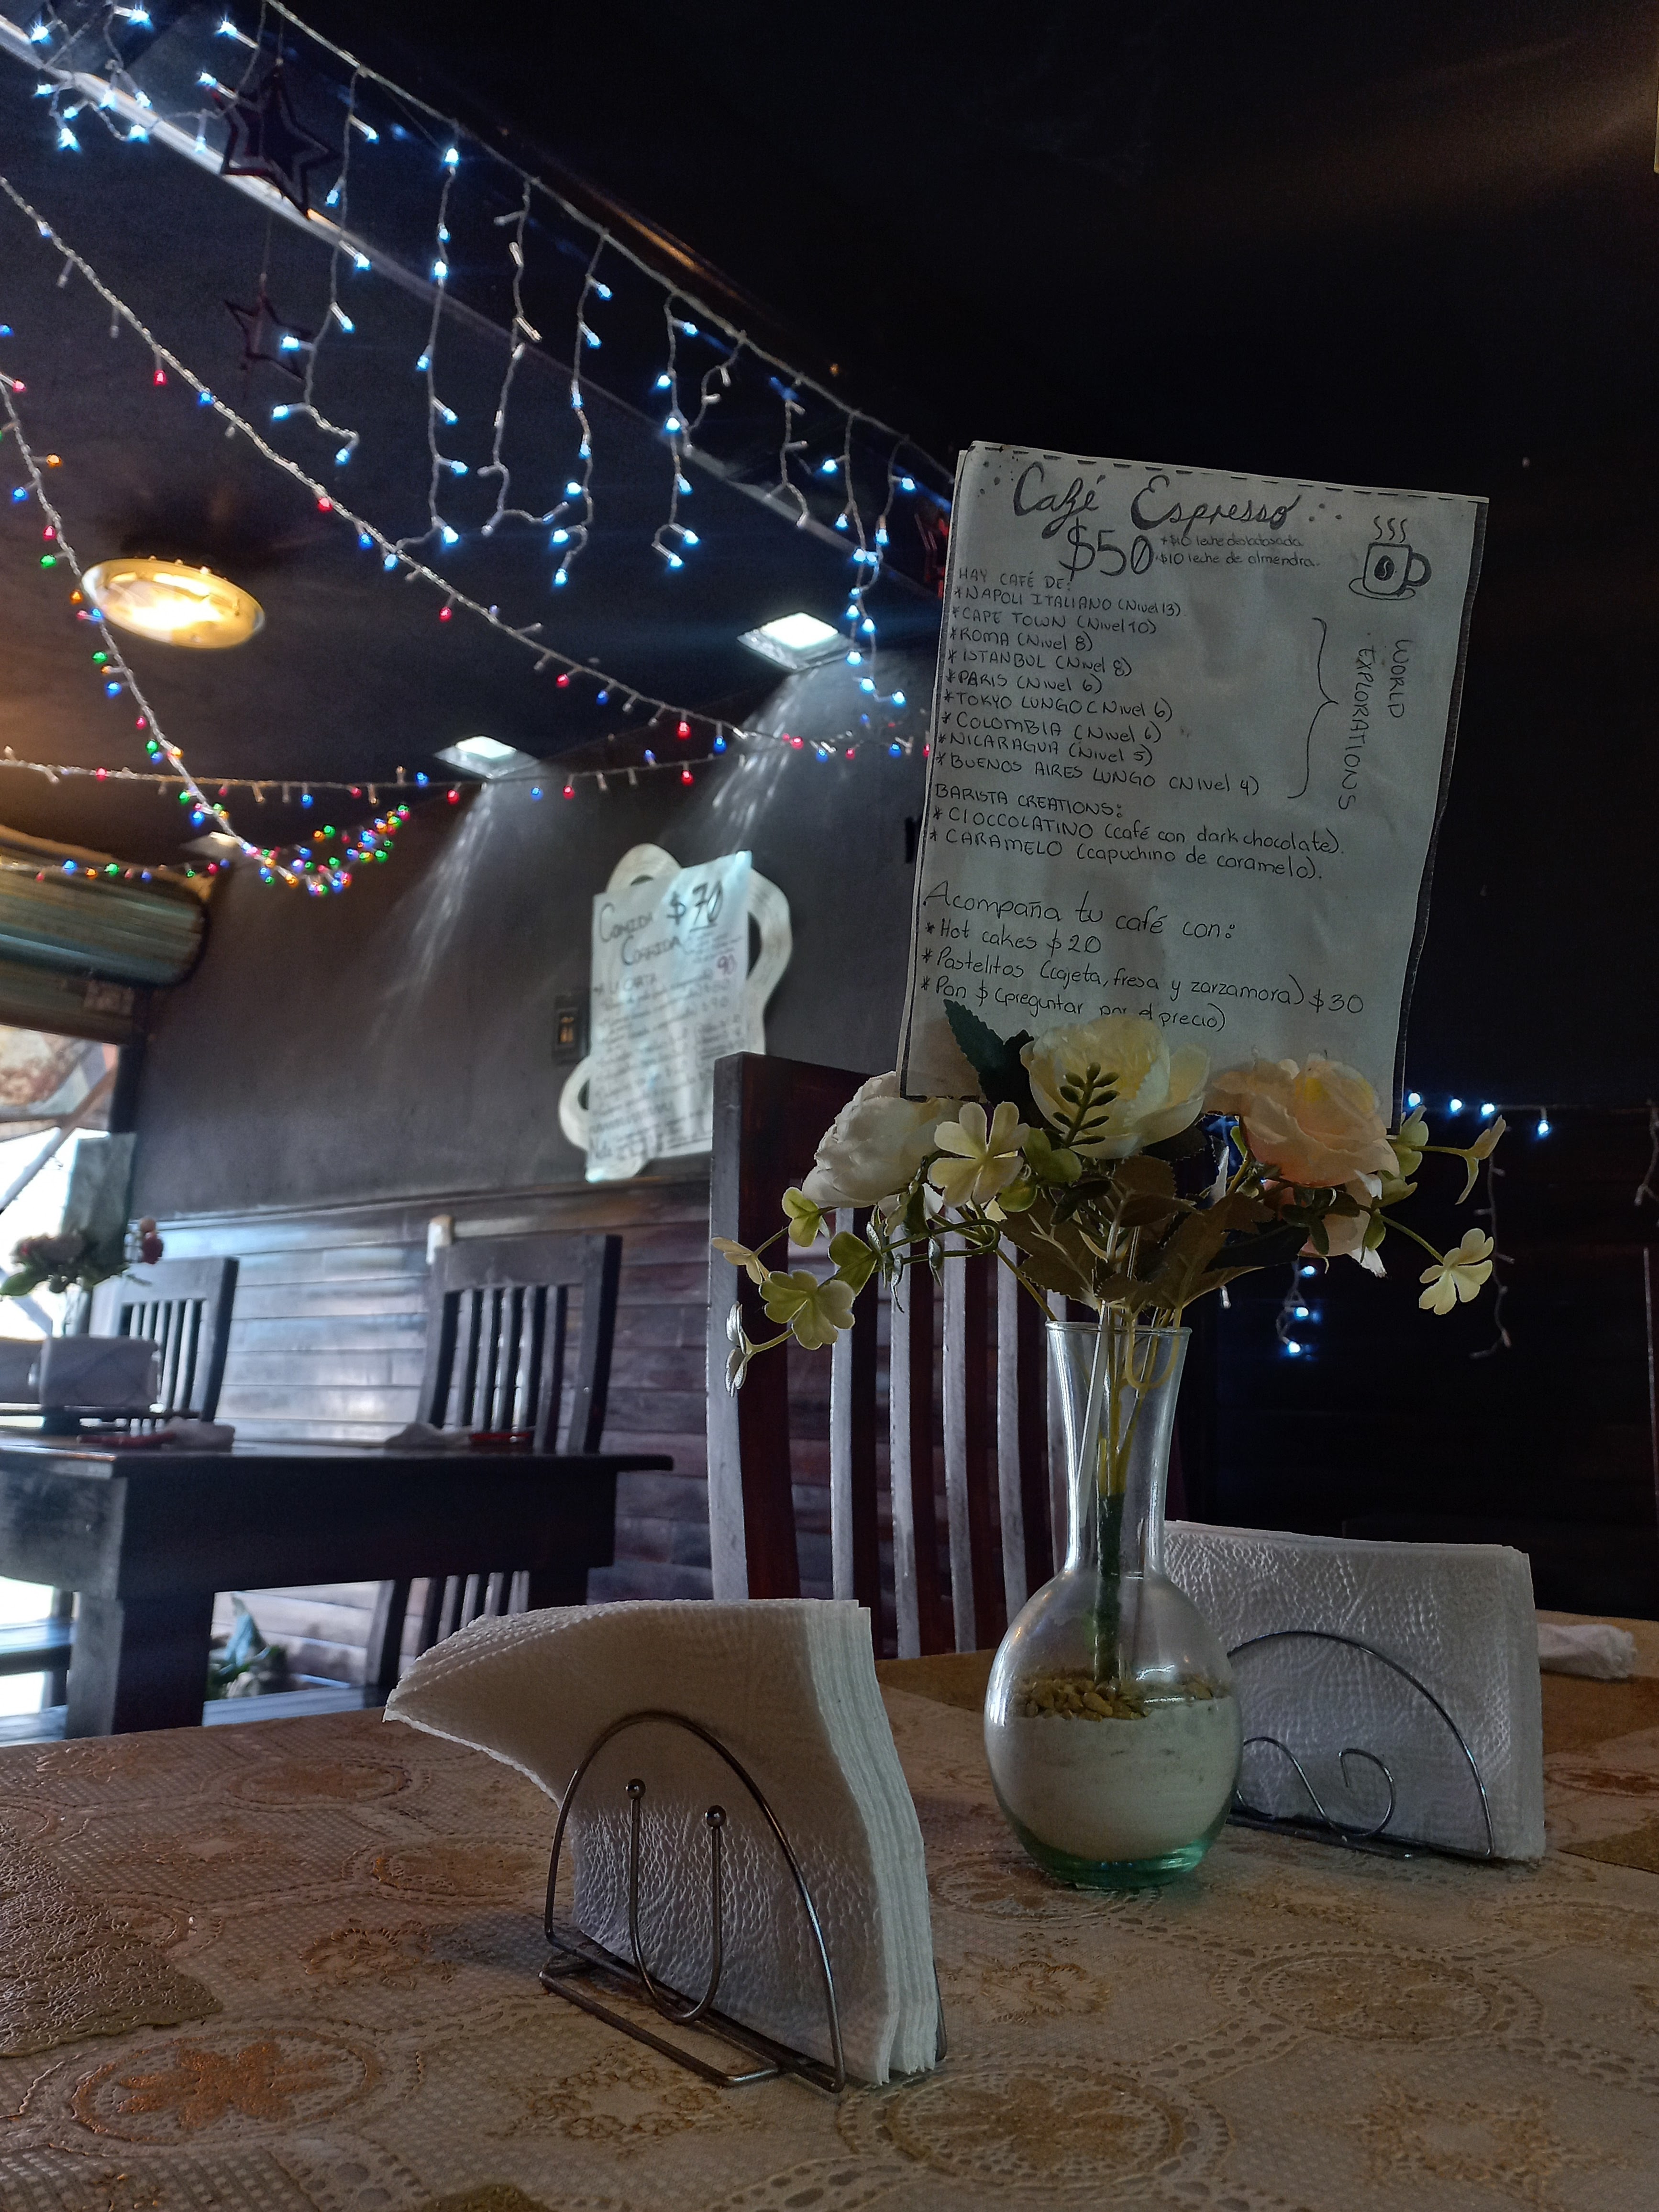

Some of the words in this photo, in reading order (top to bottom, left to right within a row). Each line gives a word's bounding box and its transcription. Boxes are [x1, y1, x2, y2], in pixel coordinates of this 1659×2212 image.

[1013, 460, 1106, 540] Café
[1130, 473, 1303, 537] Espresso
[1058, 516, 1155, 582] $50
[1188, 552, 1220, 564] leche
[1226, 551, 1243, 564] de
[1196, 534, 1224, 547] leche
[960, 567, 987, 583] HAY
[1000, 571, 1034, 588] CAFÉ
[965, 585, 1022, 605] NAPOLI
[1030, 593, 1112, 611] ITALIANO
[962, 607, 1002, 624] CAPE
[1011, 612, 1066, 628] TOWN
[1128, 619, 1157, 634] 10)
[960, 627, 1009, 646] ROMA
[1075, 630, 1093, 652] 8)
[963, 648, 1046, 669] ISTANBUL
[1113, 656, 1132, 677] 8)
[1387, 639, 1414, 718] WORLD
[958, 670, 1007, 687] PARIS
[1082, 673, 1103, 695] 6)
[956, 691, 1012, 709] TOKYO
[1021, 696, 1083, 715] LUNGO
[1154, 697, 1172, 723] 6)
[956, 711, 1062, 736] COLOMBIA
[1144, 720, 1161, 743] 6)
[1338, 645, 1377, 810] EXPLORATIONS
[950, 732, 1058, 755] NICARAGUA
[1133, 744, 1152, 767] 5)
[950, 752, 1022, 773] BUENOS
[1035, 761, 1083, 779] AIRES
[1093, 767, 1155, 788] LUNGO
[1240, 775, 1259, 796] 4)
[935, 783, 1008, 805] BARISTA
[1018, 795, 1123, 818] CREATIONS:
[949, 807, 1093, 839] CIOCCOLATINO
[1105, 819, 1150, 841] (café
[1158, 830, 1185, 843] con
[1197, 825, 1239, 843] dark
[946, 829, 1062, 857] CARAMELO
[1077, 843, 1176, 864] (capuchino
[1186, 845, 1208, 865] de
[1217, 855, 1322, 880] caramelo).
[923, 880, 1063, 922] Acompaña
[1075, 890, 1103, 923] tu
[1116, 905, 1168, 934] café
[1182, 921, 1235, 939] con:
[940, 918, 970, 939] Hot
[982, 923, 1037, 950] cakes
[937, 946, 1024, 978] Pastelitos
[1040, 960, 1109, 990] (cajeta,
[1113, 967, 1159, 990] fresa
[1170, 980, 1181, 1002] y
[1191, 973, 1304, 1005] zarzamora)
[1308, 988, 1364, 1014] $30
[936, 975, 966, 998] Pan
[995, 987, 1084, 1018] (preguntar
[1157, 1002, 1225, 1032] precio)
